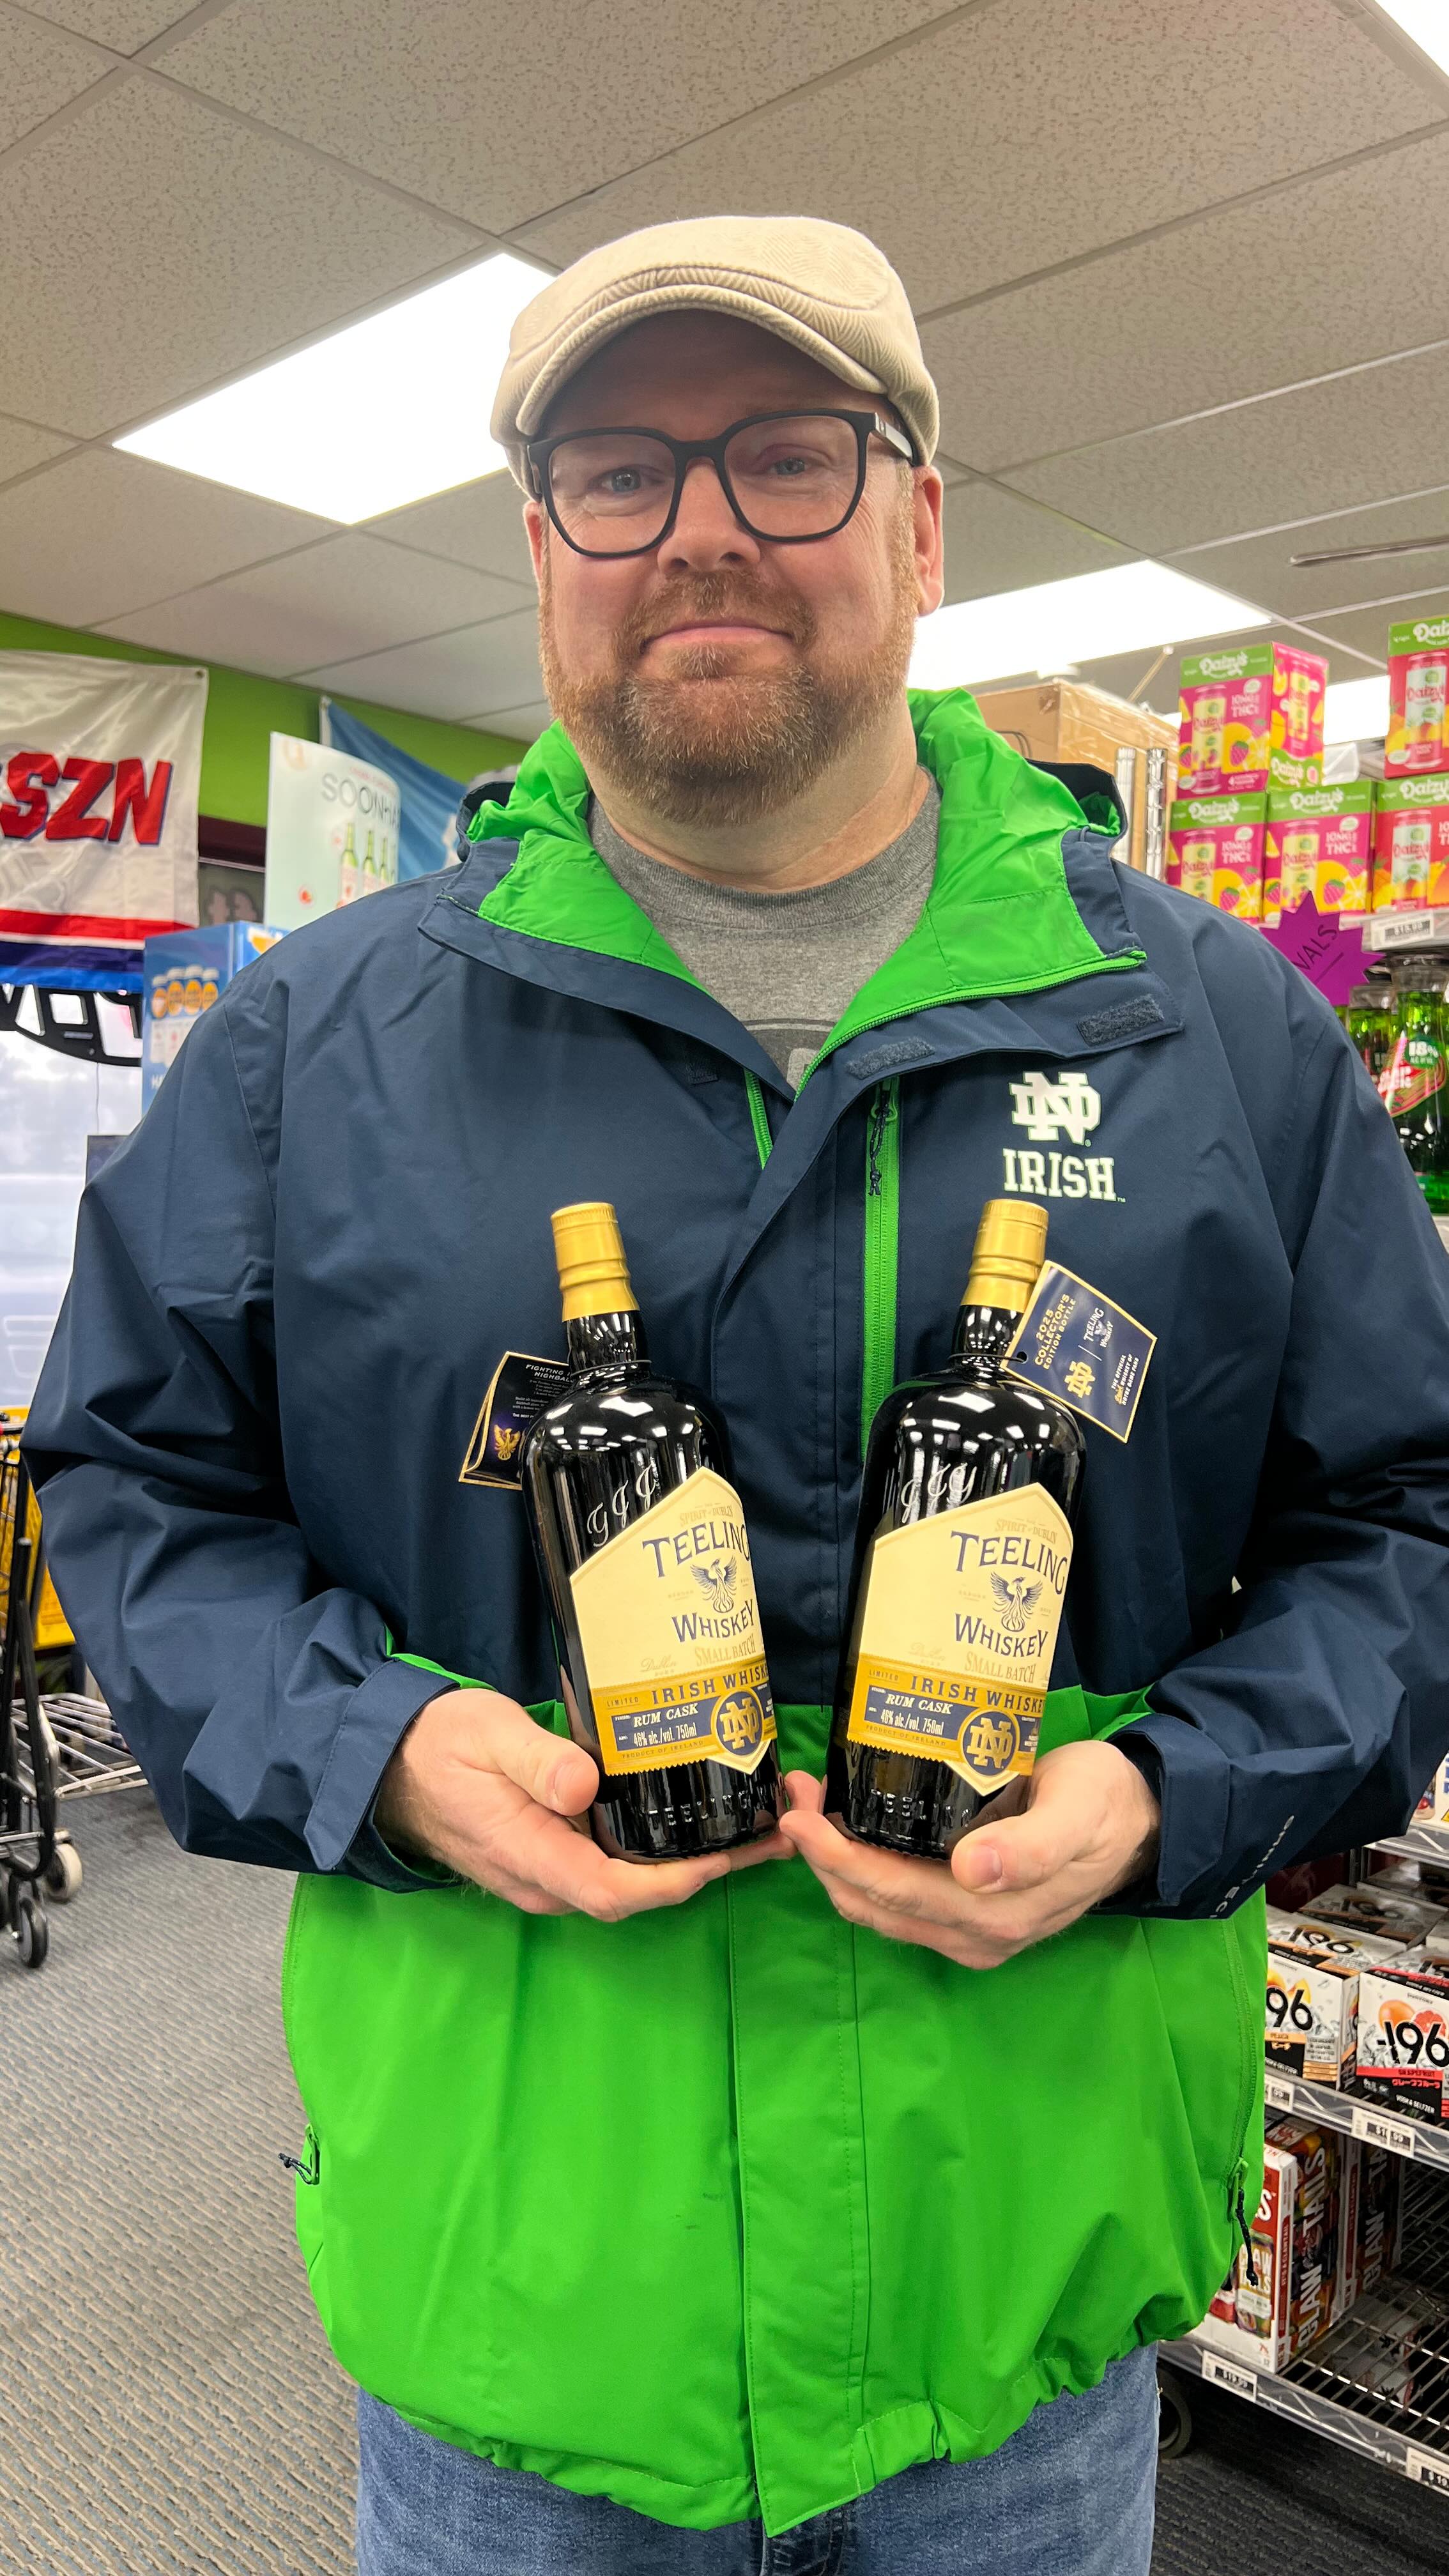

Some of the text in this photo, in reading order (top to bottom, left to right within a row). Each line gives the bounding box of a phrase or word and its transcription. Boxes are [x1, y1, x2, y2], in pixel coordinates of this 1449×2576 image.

[0, 750, 173, 848] SZN
[1002, 1148, 1117, 1202] IRISH
[1035, 1294, 1070, 1365] COLLECTOR'S
[1036, 1309, 1054, 1340] 2025
[1043, 1298, 1076, 1370] EDITION BOTTLE
[1084, 1307, 1105, 1342] TEELING
[525, 1364, 564, 1375] FIGHTING
[951, 1531, 1068, 1595] TEELING
[672, 1598, 753, 1643] WHISKEY
[955, 1613, 1048, 1657] WHISKEY
[695, 1633, 755, 1666] SMALL BATCH
[869, 1669, 898, 1682] LIMITED
[964, 1651, 1036, 1684] SMALL BATCH
[607, 1696, 639, 1707] LIMITED
[652, 1678, 716, 1705] IRISH
[885, 1693, 953, 1715] RUM CASK
[910, 1676, 977, 1702] IRISH
[634, 1703, 698, 1728] RUM CASK
[881, 1708, 894, 1726] 46%
[924, 1717, 944, 1736] 750ml
[622, 1749, 655, 1759] PRODUCT
[671, 1740, 703, 1752] IRELAND
[634, 1731, 648, 1748] 46%
[676, 1722, 698, 1740] 750ml
[866, 1724, 897, 1736] PRODUCT
[912, 1734, 946, 1746] IRELAND
[1377, 2021, 1449, 2067] -196
[1298, 2147, 1324, 2347] CLAW TAILS
[1362, 2211, 1384, 2290] CLAW
